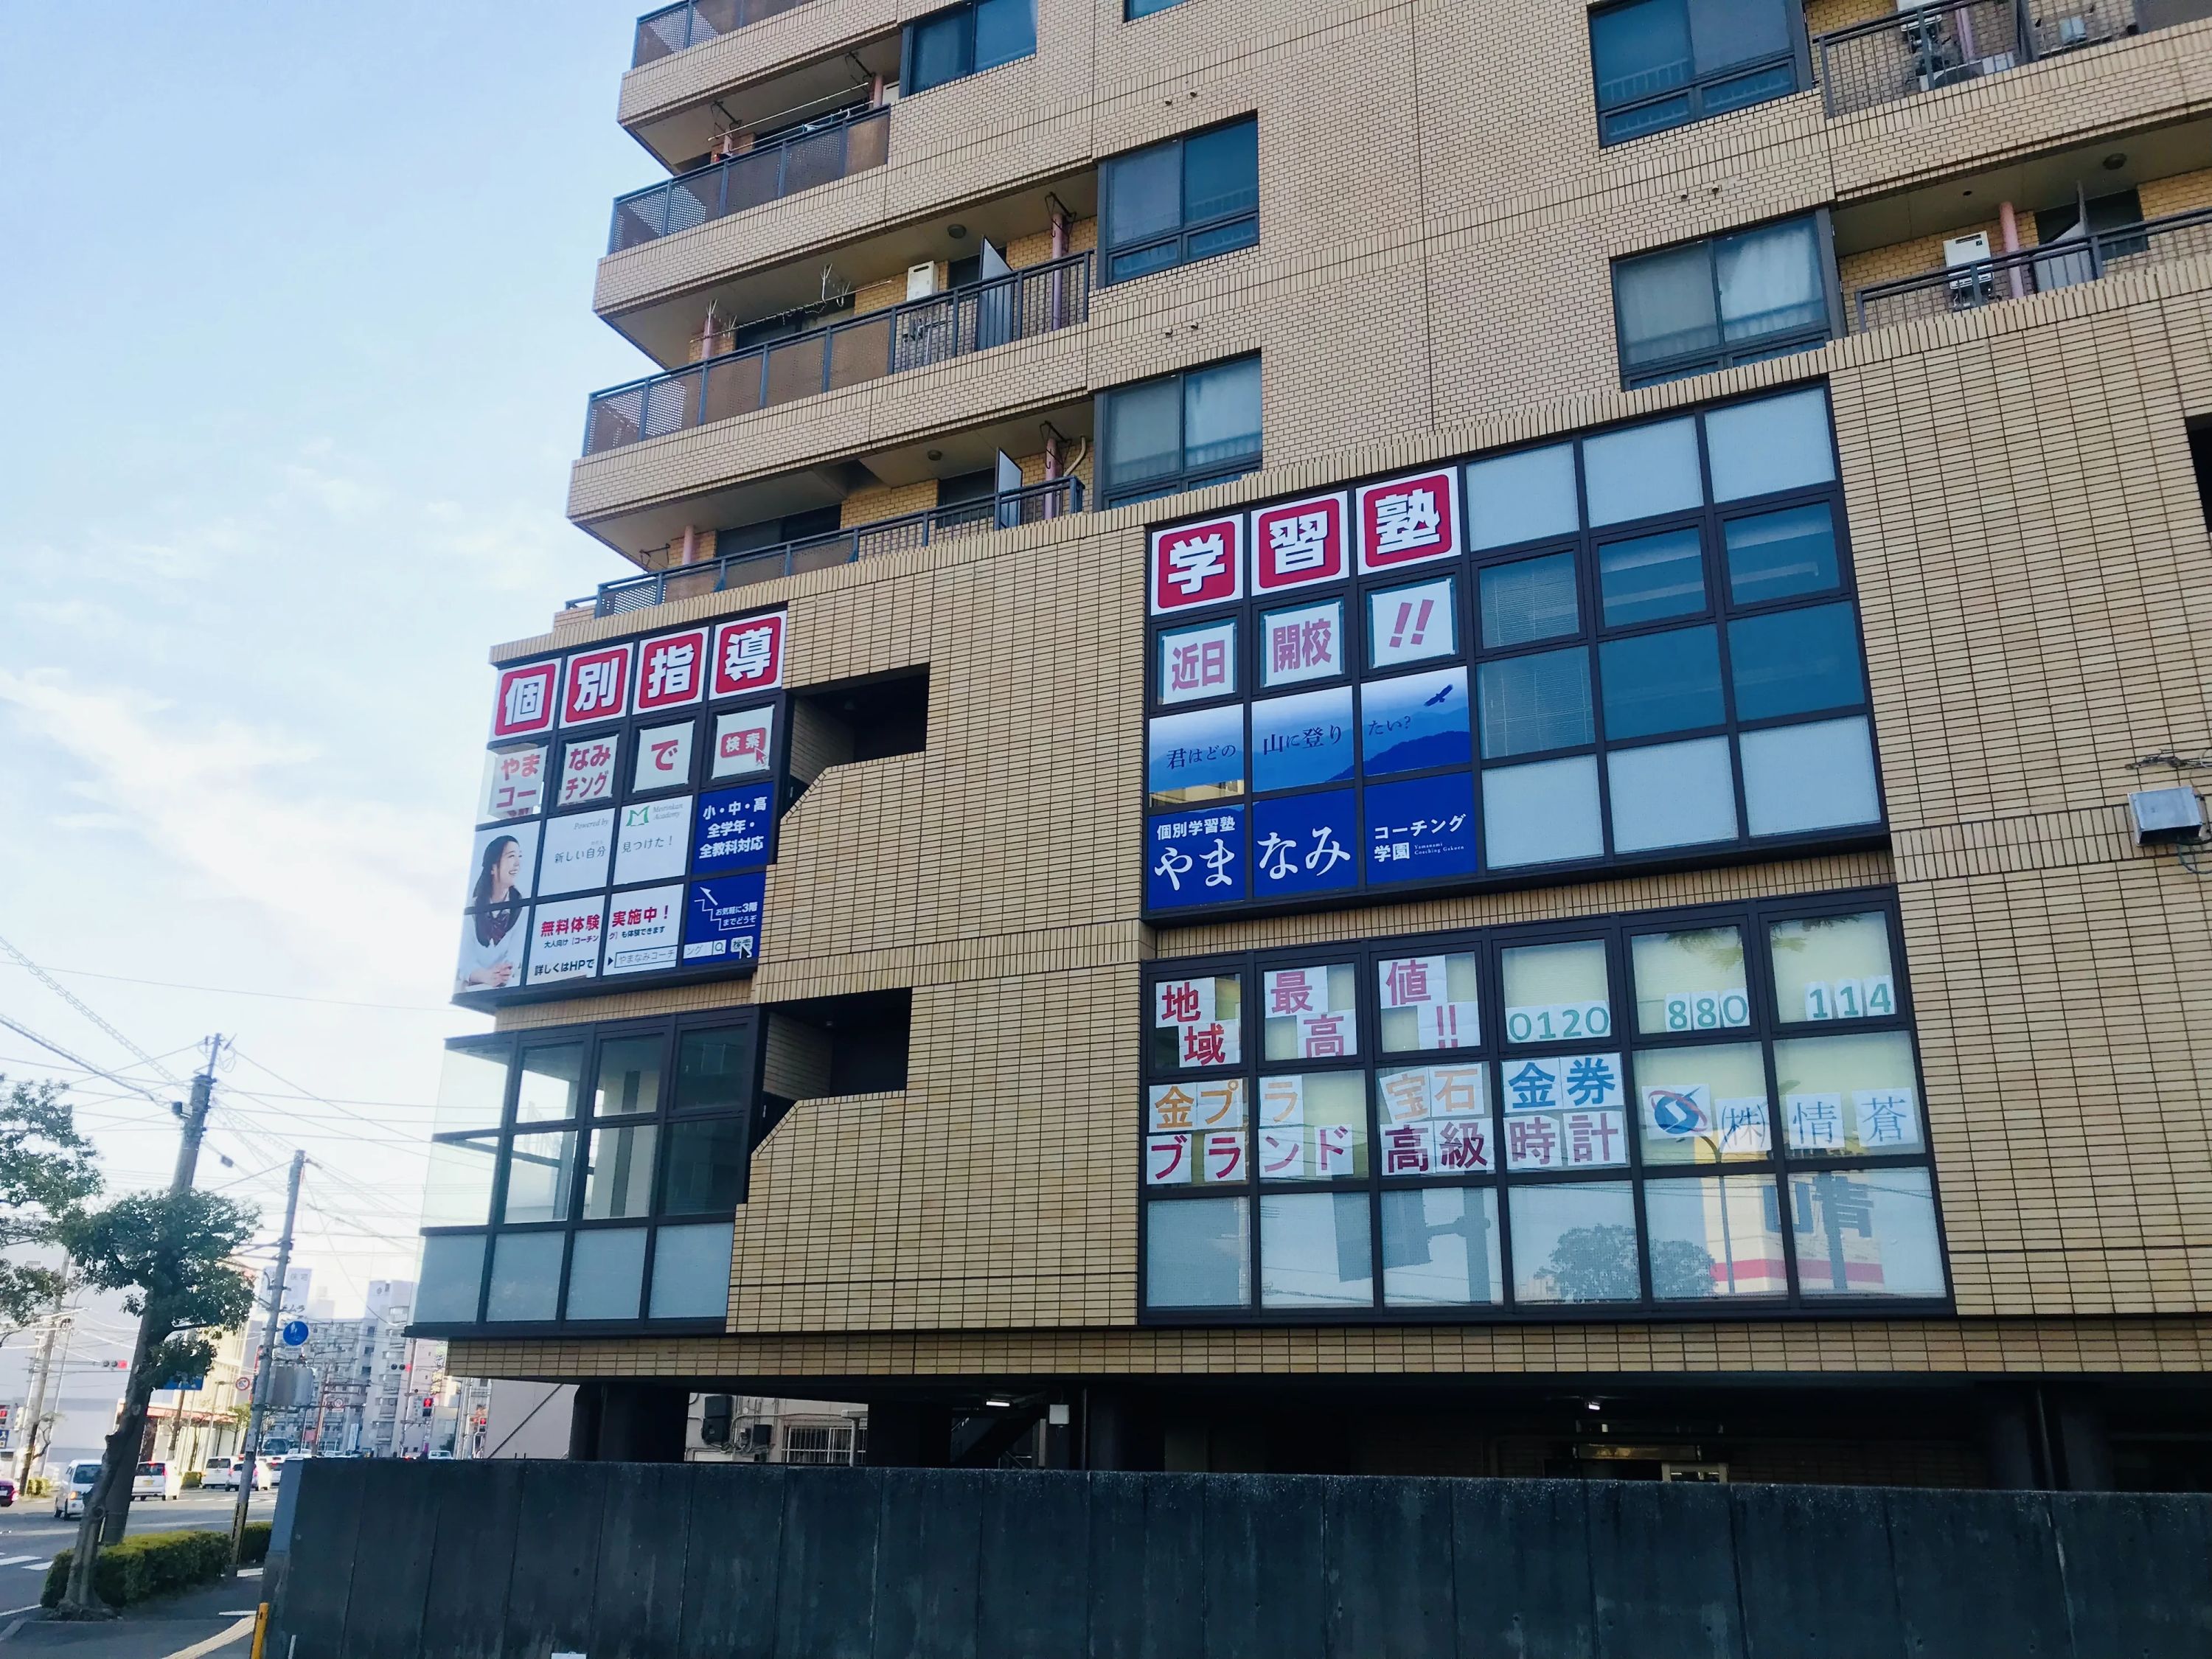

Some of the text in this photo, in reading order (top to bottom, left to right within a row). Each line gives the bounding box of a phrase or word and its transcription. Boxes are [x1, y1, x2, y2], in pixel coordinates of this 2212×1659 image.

[1168, 487, 1441, 594] 学習塾
[1171, 639, 1225, 692] 近日
[1273, 617, 1332, 673] 開校
[504, 626, 773, 726] 個別指導
[651, 739, 678, 772] で
[725, 731, 761, 754] 検索
[653, 811, 681, 821] Academy
[703, 796, 768, 821] 小・中・高
[574, 818, 609, 830] Powered by
[1155, 815, 1236, 841] 個別学習塾
[1374, 813, 1467, 840] コーチング
[698, 835, 765, 860] 全教科対応
[1154, 826, 1352, 891] やまなみ
[1374, 842, 1410, 863] 学園
[1413, 842, 1443, 850] Yamanami
[723, 914, 758, 927] までどうぞ
[535, 959, 596, 976] 詳しくはHPで
[1508, 983, 1893, 1040] 0120 880 114
[1154, 1057, 1617, 1130] 金プラ 宝石 金券
[1150, 1124, 1349, 1180] ブランド
